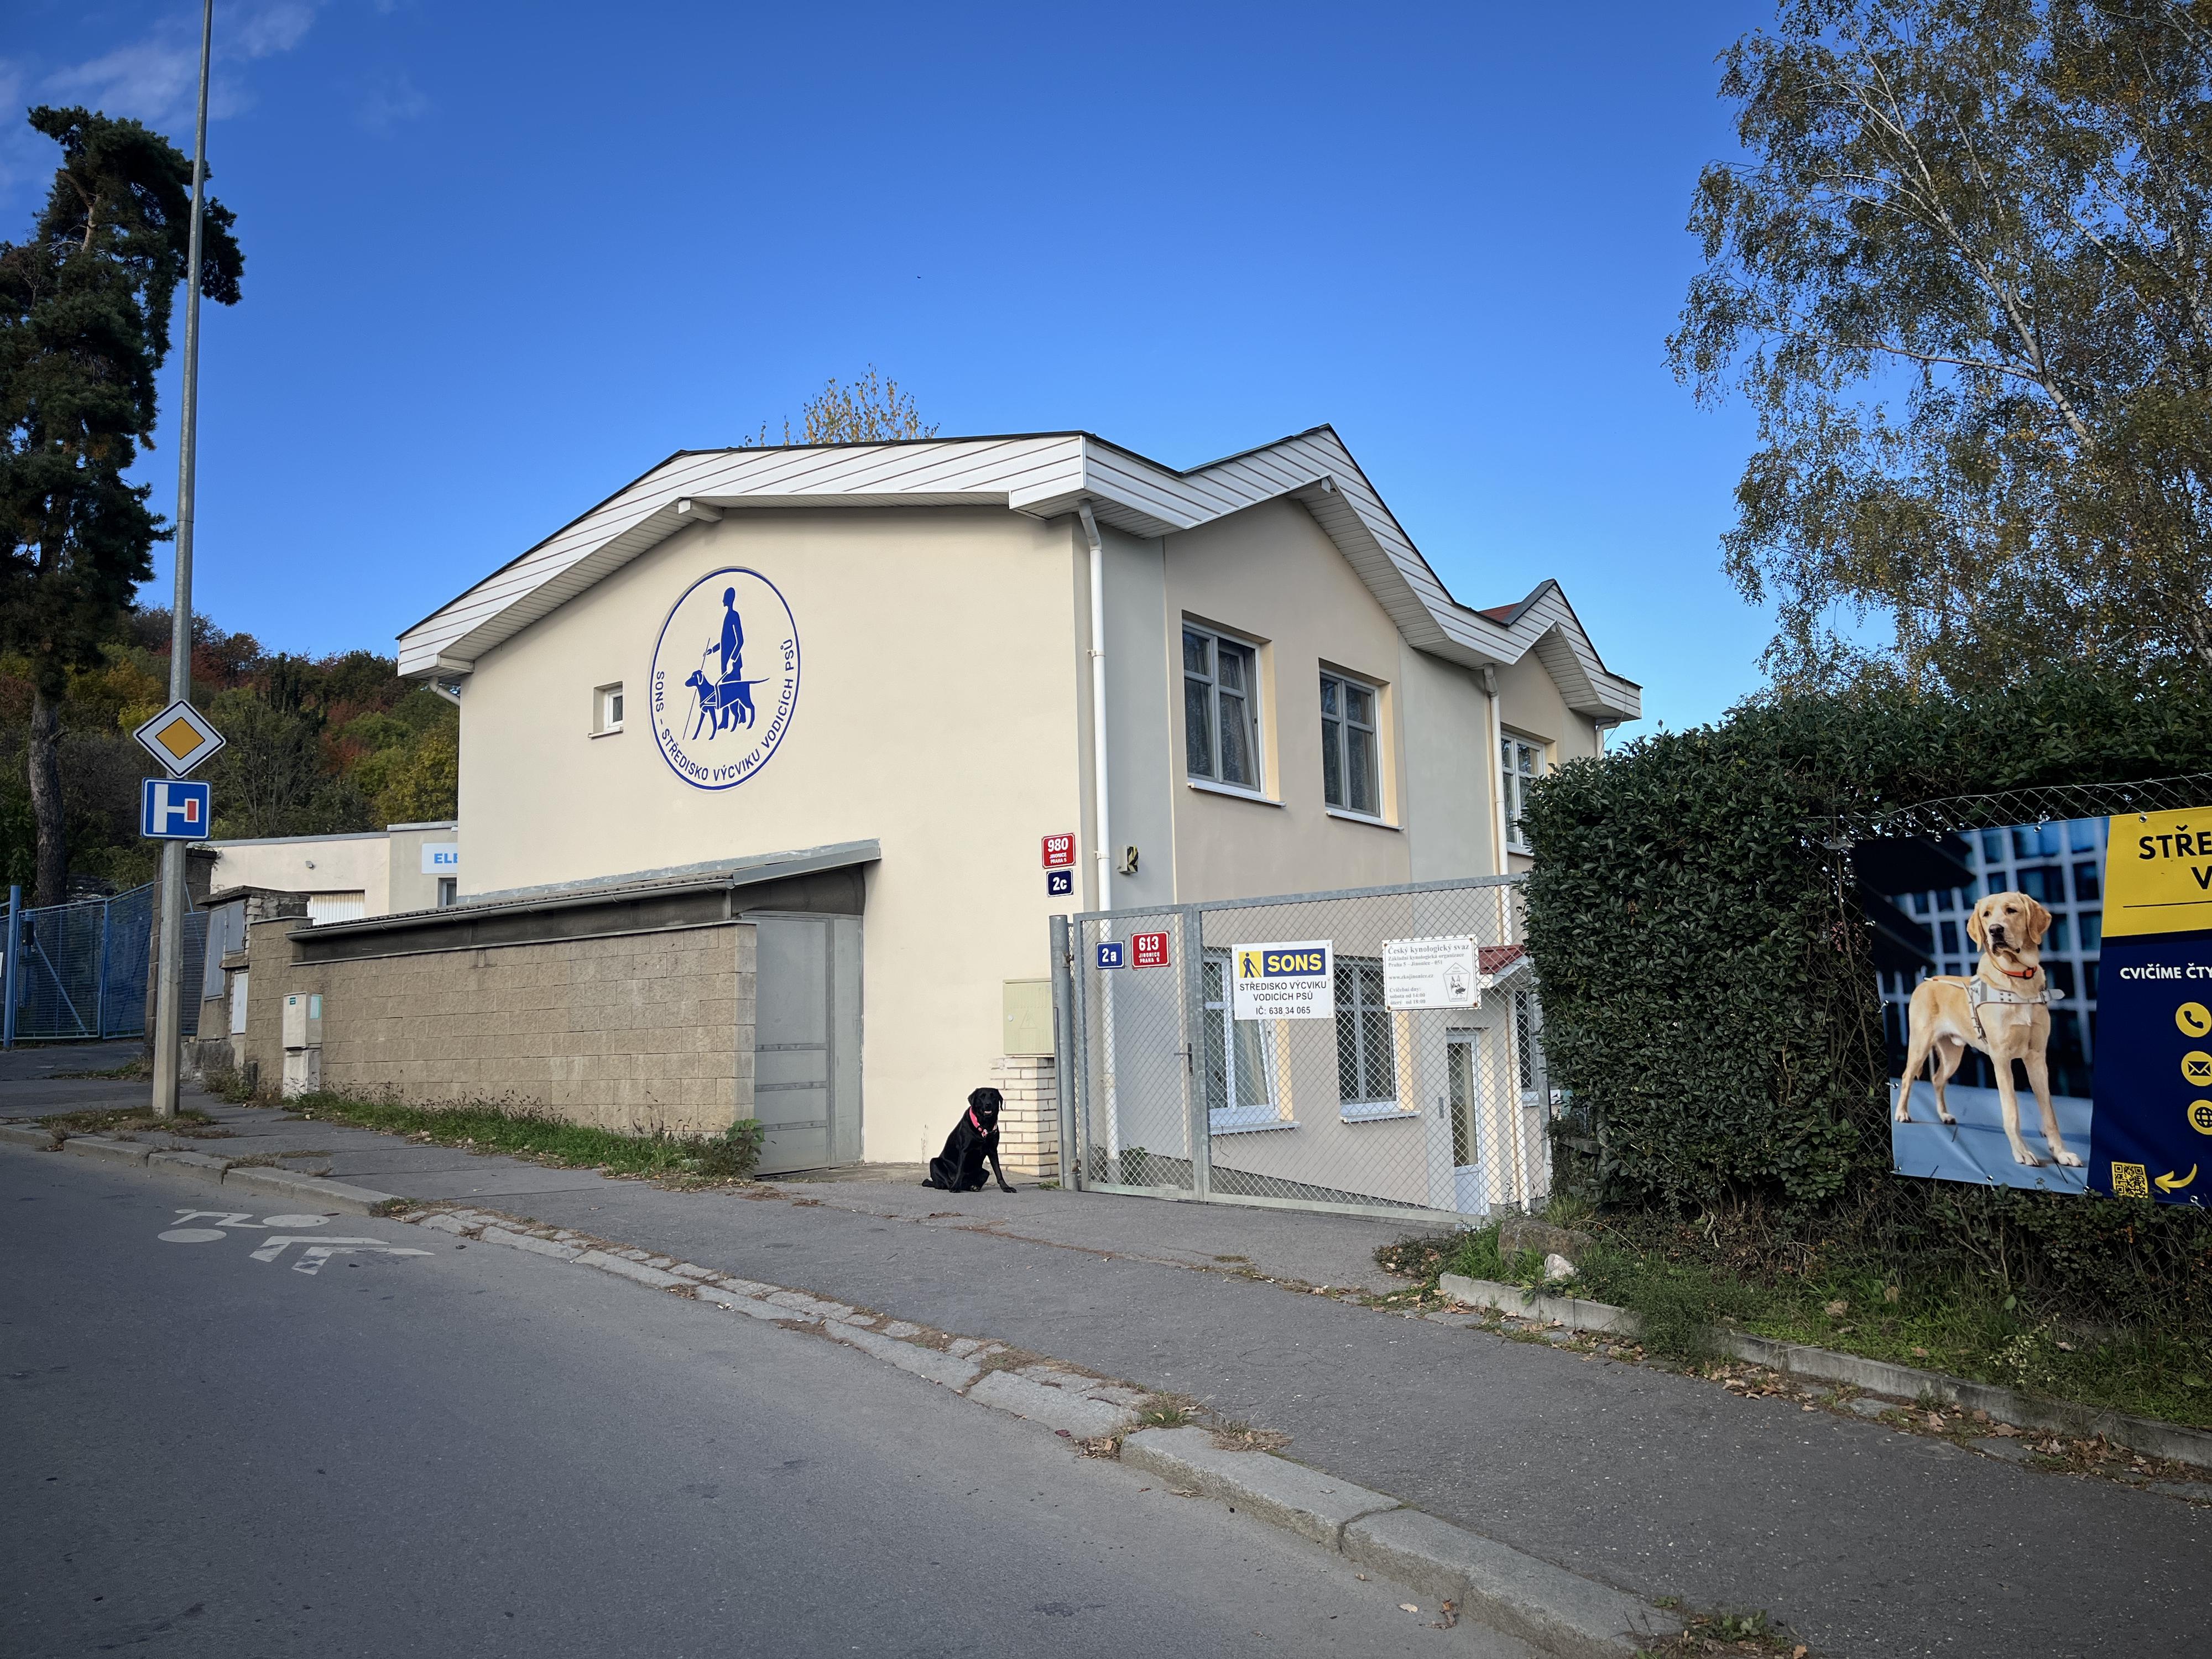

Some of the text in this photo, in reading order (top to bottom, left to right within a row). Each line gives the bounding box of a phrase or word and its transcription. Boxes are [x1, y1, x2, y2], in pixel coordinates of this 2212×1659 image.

[655, 671, 665, 712] SONS
[661, 728, 708, 781] STŘEDISKO
[713, 748, 760, 781] VÝCVIKU
[761, 678, 794, 749] VODICÍCH
[780, 639, 795, 672] PSŮ
[1047, 837, 1068, 852] 980
[1052, 877, 1067, 891] 2c
[1139, 936, 1159, 951] 613
[1388, 946, 1408, 955] Český
[1410, 944, 1452, 954] kynologický
[1102, 948, 1117, 962] 2a
[1267, 953, 1322, 972] SONS
[2120, 964, 2182, 979] CVIČÍME
[1240, 980, 1327, 991] STŘEDISKO VÝCVIKU
[1253, 990, 1313, 1001] VODICÍCH PSŮ
[1256, 1006, 1266, 1015] IČ:
